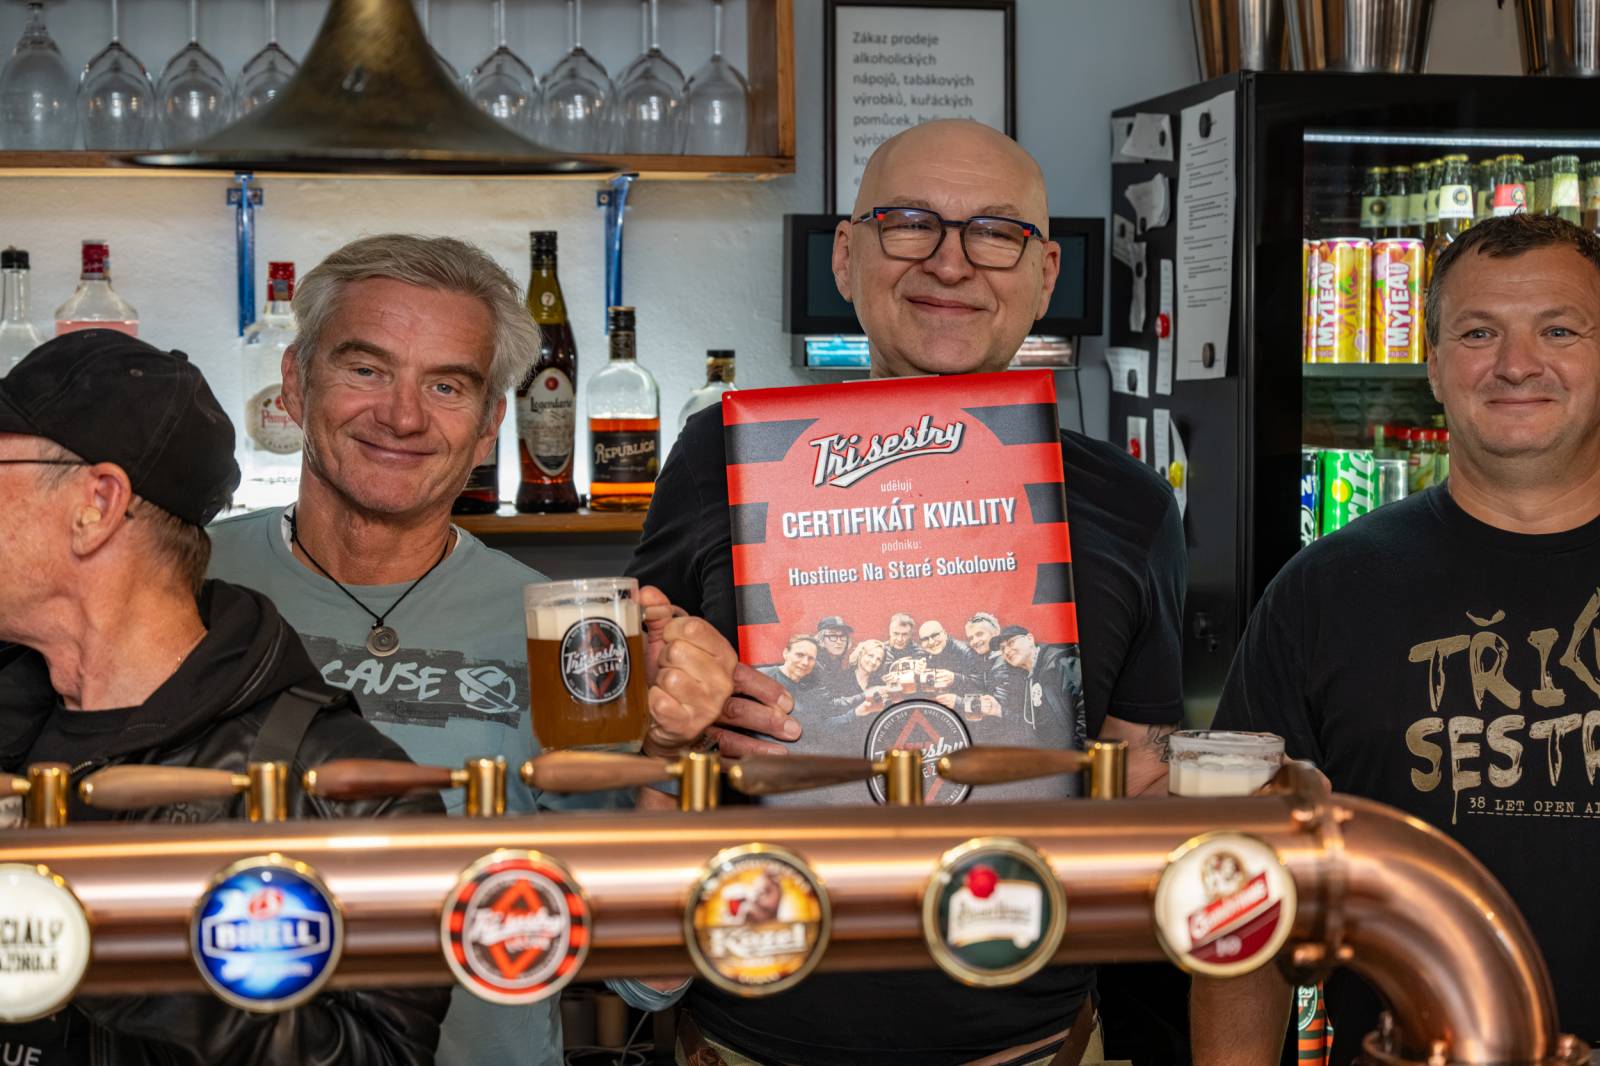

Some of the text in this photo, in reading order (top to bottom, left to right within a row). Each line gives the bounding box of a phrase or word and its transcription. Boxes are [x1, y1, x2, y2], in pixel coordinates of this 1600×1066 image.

[853, 31, 939, 47] Zákaz prodeje
[853, 52, 936, 66] alkoholických
[853, 72, 974, 88] nápojů, tabákových
[853, 92, 973, 108] výrobků, kuřáckých
[853, 113, 913, 126] pomůcek,
[810, 415, 966, 487] Tři sestry
[1338, 449, 1374, 522] rite
[782, 496, 1016, 539] CERTIFIKÁT KVALITY
[881, 540, 922, 554] podniku:
[789, 551, 1016, 587] Hostinec Na Staré Sokolovně
[1470, 796, 1486, 809] 38
[1495, 800, 1525, 812] LET
[1534, 801, 1575, 813] OPEN
[0, 1042, 42, 1066] UE
